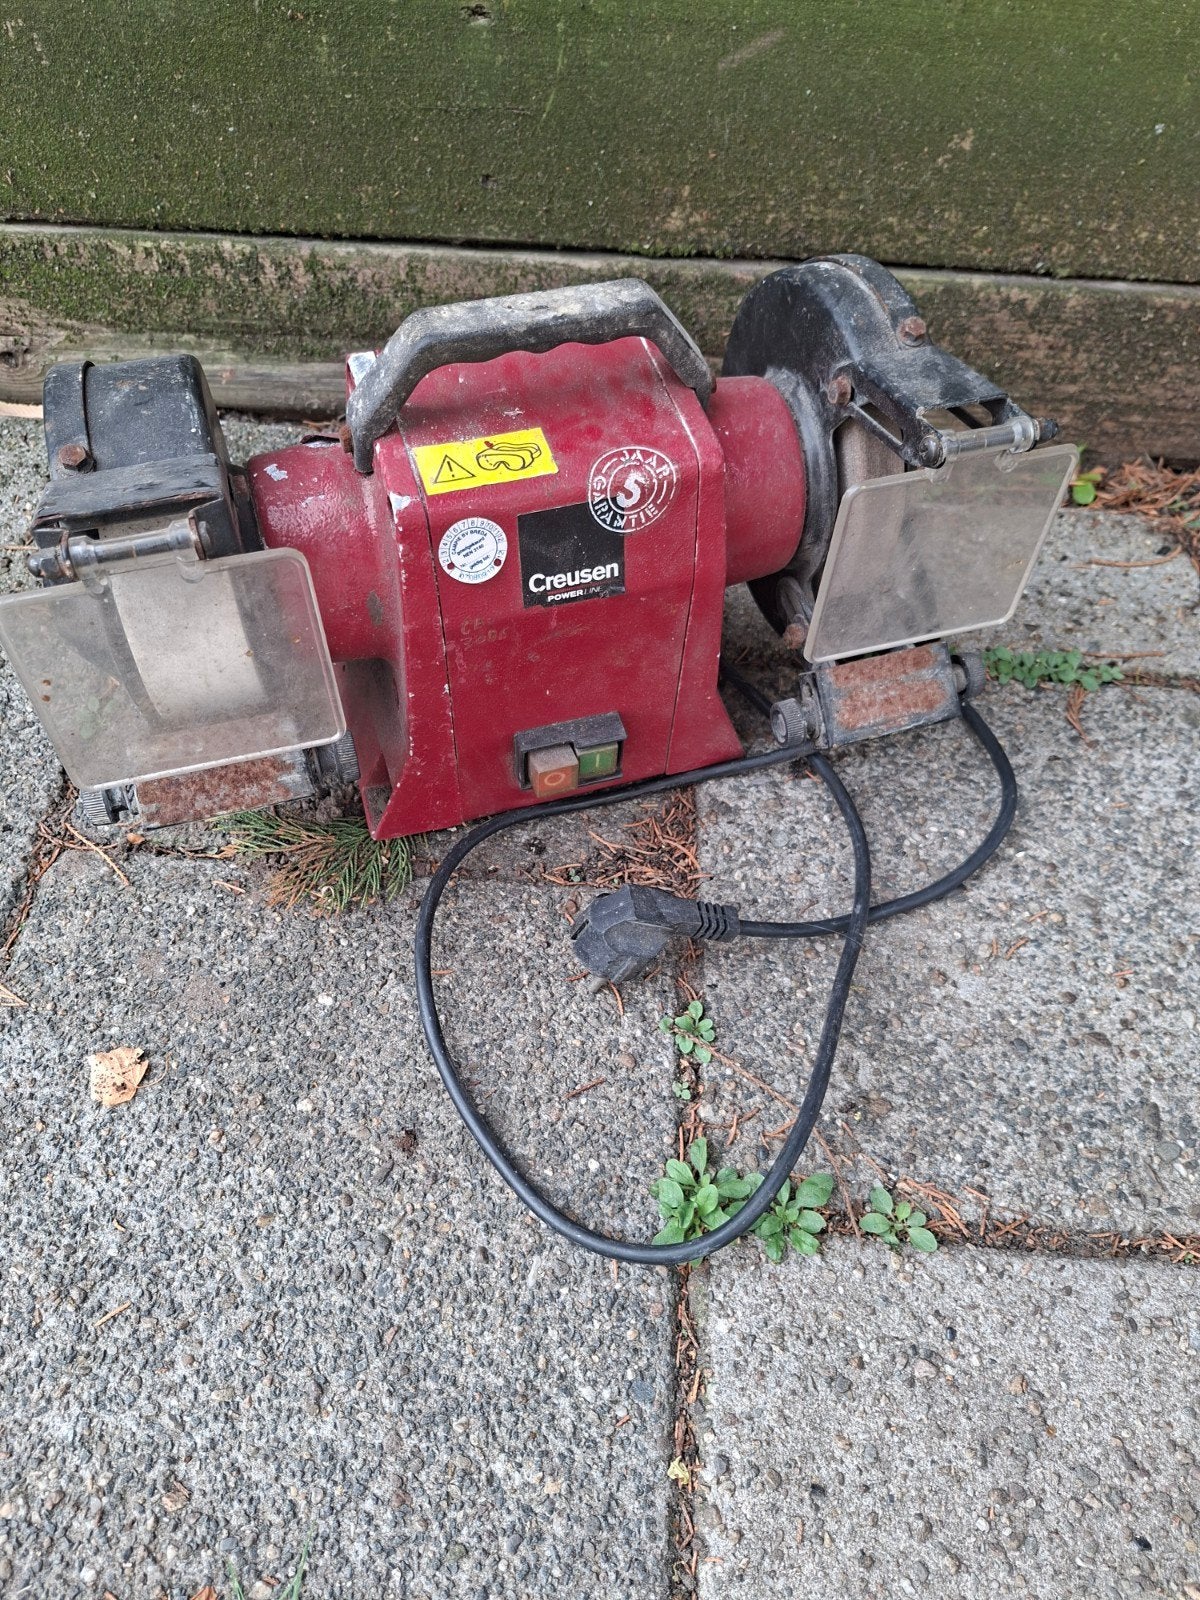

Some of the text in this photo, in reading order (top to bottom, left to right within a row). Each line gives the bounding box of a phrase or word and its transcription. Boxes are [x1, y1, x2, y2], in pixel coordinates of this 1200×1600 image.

[620, 450, 670, 479] JAAR
[593, 476, 658, 528] GARANTIE
[528, 562, 619, 593] Creusen
